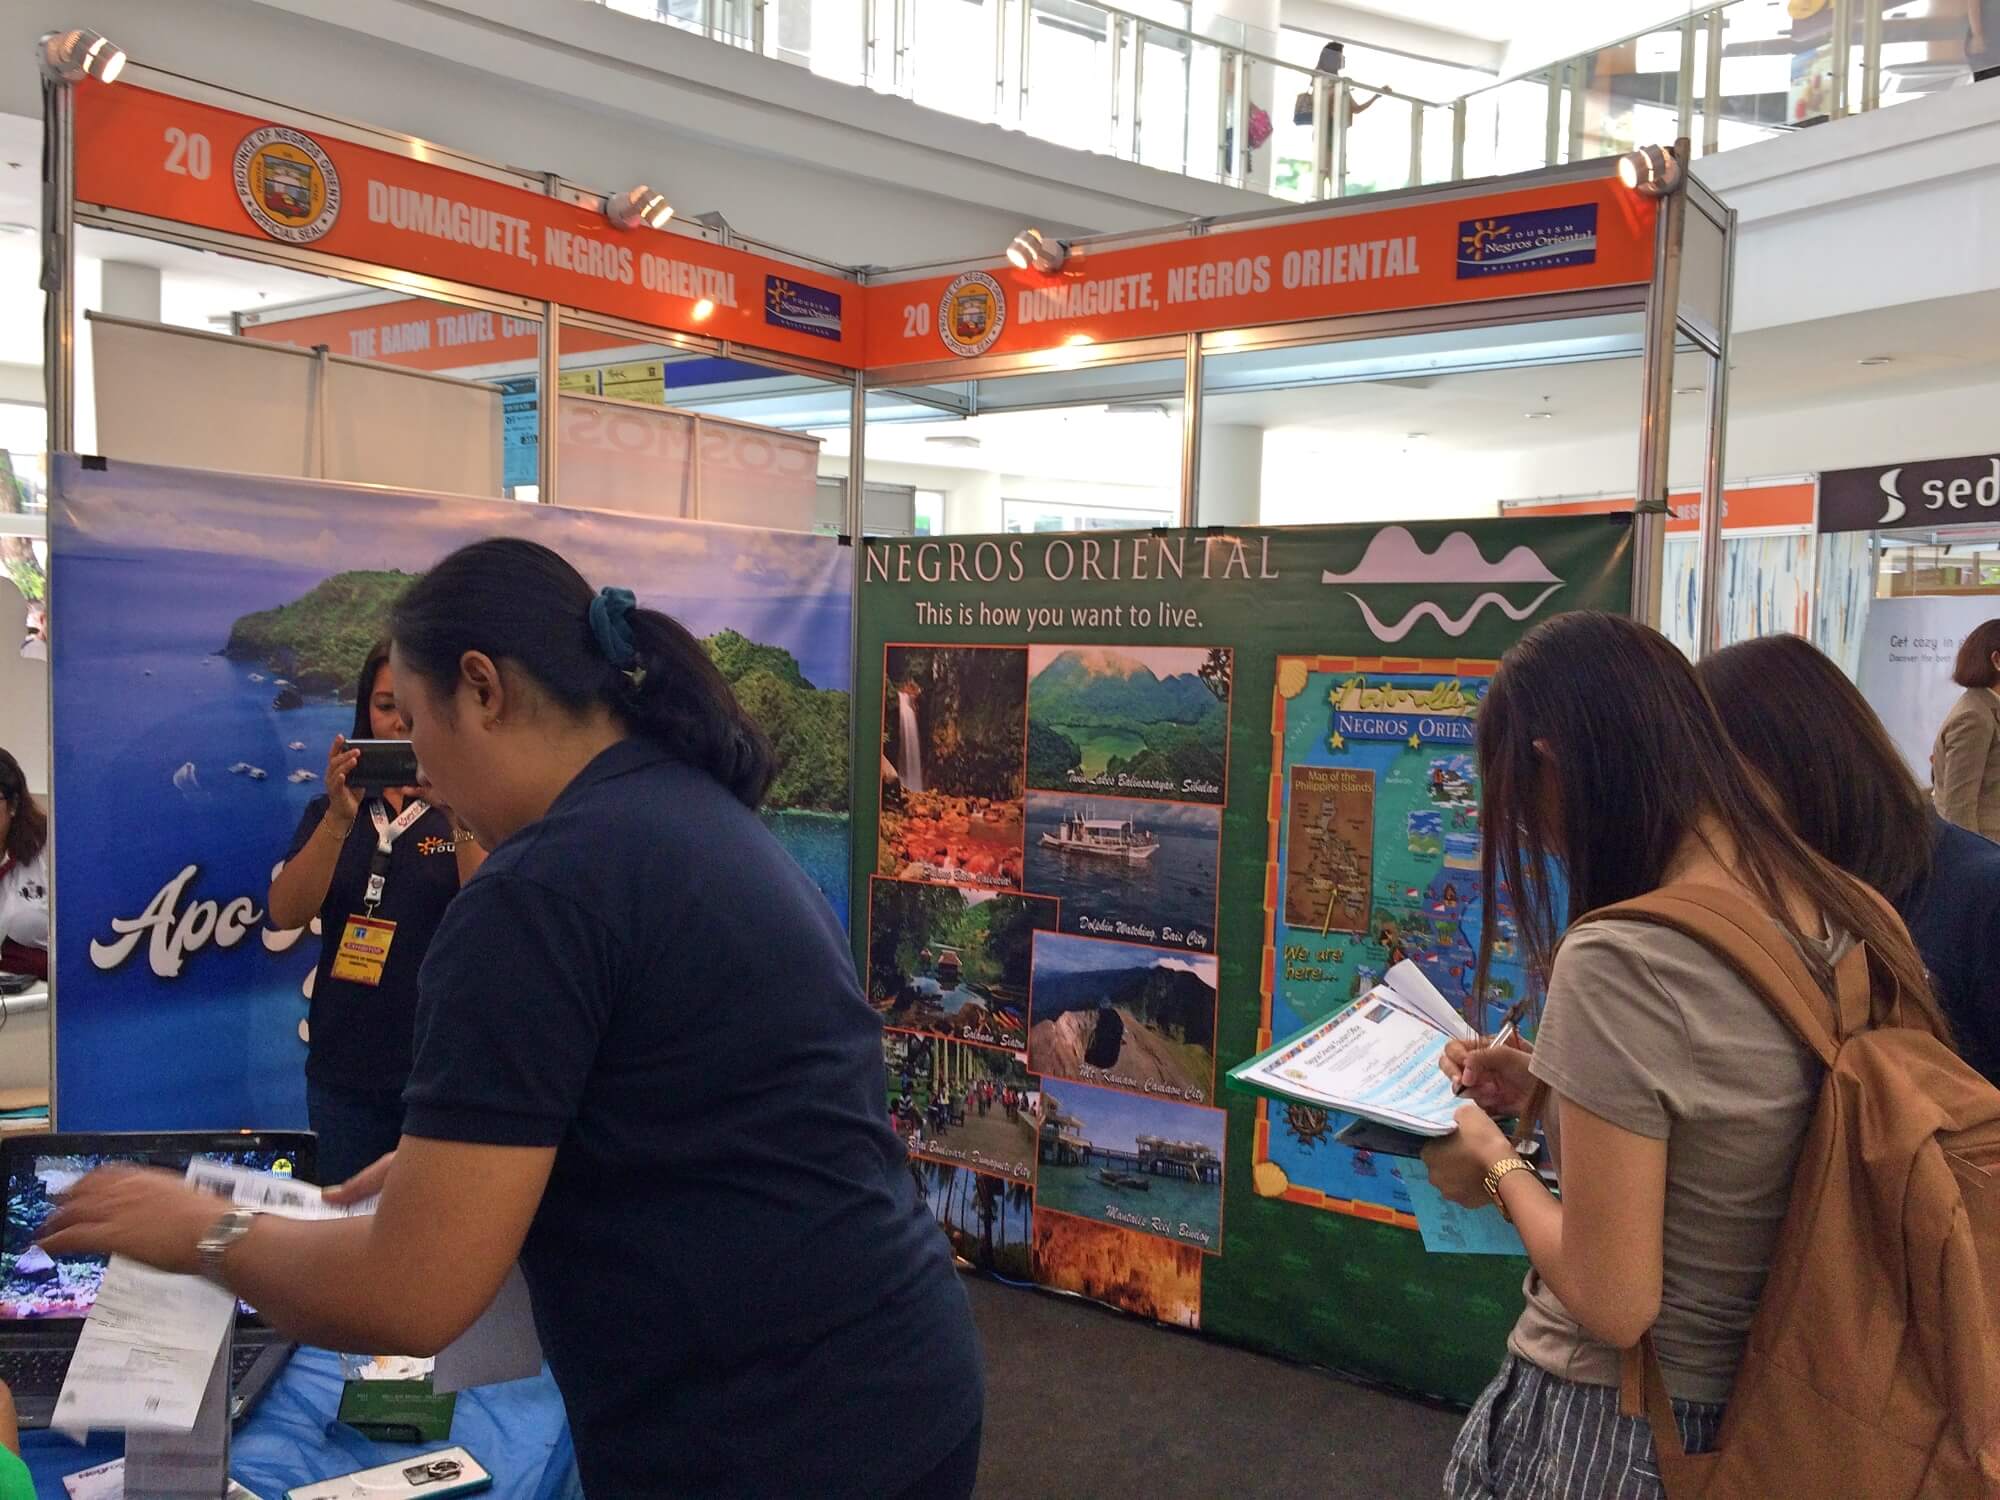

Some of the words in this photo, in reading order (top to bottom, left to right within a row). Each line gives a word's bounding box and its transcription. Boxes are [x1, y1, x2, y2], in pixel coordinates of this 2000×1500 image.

[164, 127, 212, 180] 20
[367, 179, 537, 266] DUMAGUETE,
[544, 226, 633, 286] NEGROS
[640, 253, 738, 309] ORIENTAL
[1485, 239, 1533, 255] Negros
[1534, 229, 1593, 248] Oriental
[1506, 224, 1574, 240] TOURISM
[1018, 271, 1159, 325] DUMAGUETE,
[1167, 255, 1270, 305] NEGROS
[1282, 235, 1420, 290] ORIENTAL
[350, 324, 377, 359] THE
[380, 314, 431, 355] BARON
[436, 306, 496, 348] TRAVEL
[903, 303, 930, 338] 20
[864, 540, 1025, 583] NEGROS
[1044, 535, 1280, 580] ORIENTAL
[915, 601, 953, 627] This
[958, 602, 974, 627] is
[979, 601, 1021, 626] how
[1027, 608, 1064, 632] you
[1071, 603, 1122, 628] want
[1129, 605, 1151, 628] to
[1159, 601, 1204, 629] live.
[1338, 715, 1409, 737] NEGROS
[1418, 718, 1474, 739] ORIEN
[1294, 781, 1340, 794] Philippine
[1341, 781, 1373, 793] Islands
[1308, 770, 1328, 784] Map
[1330, 771, 1339, 782] of
[1341, 773, 1357, 783] the
[430, 843, 457, 855] TOU
[89, 864, 264, 977] Apo
[1079, 916, 1114, 934] Dolphin
[1162, 926, 1184, 942] Bais
[1186, 930, 1208, 948] City
[1283, 944, 1309, 962] We
[1316, 947, 1344, 964] are
[1184, 1084, 1205, 1103] City
